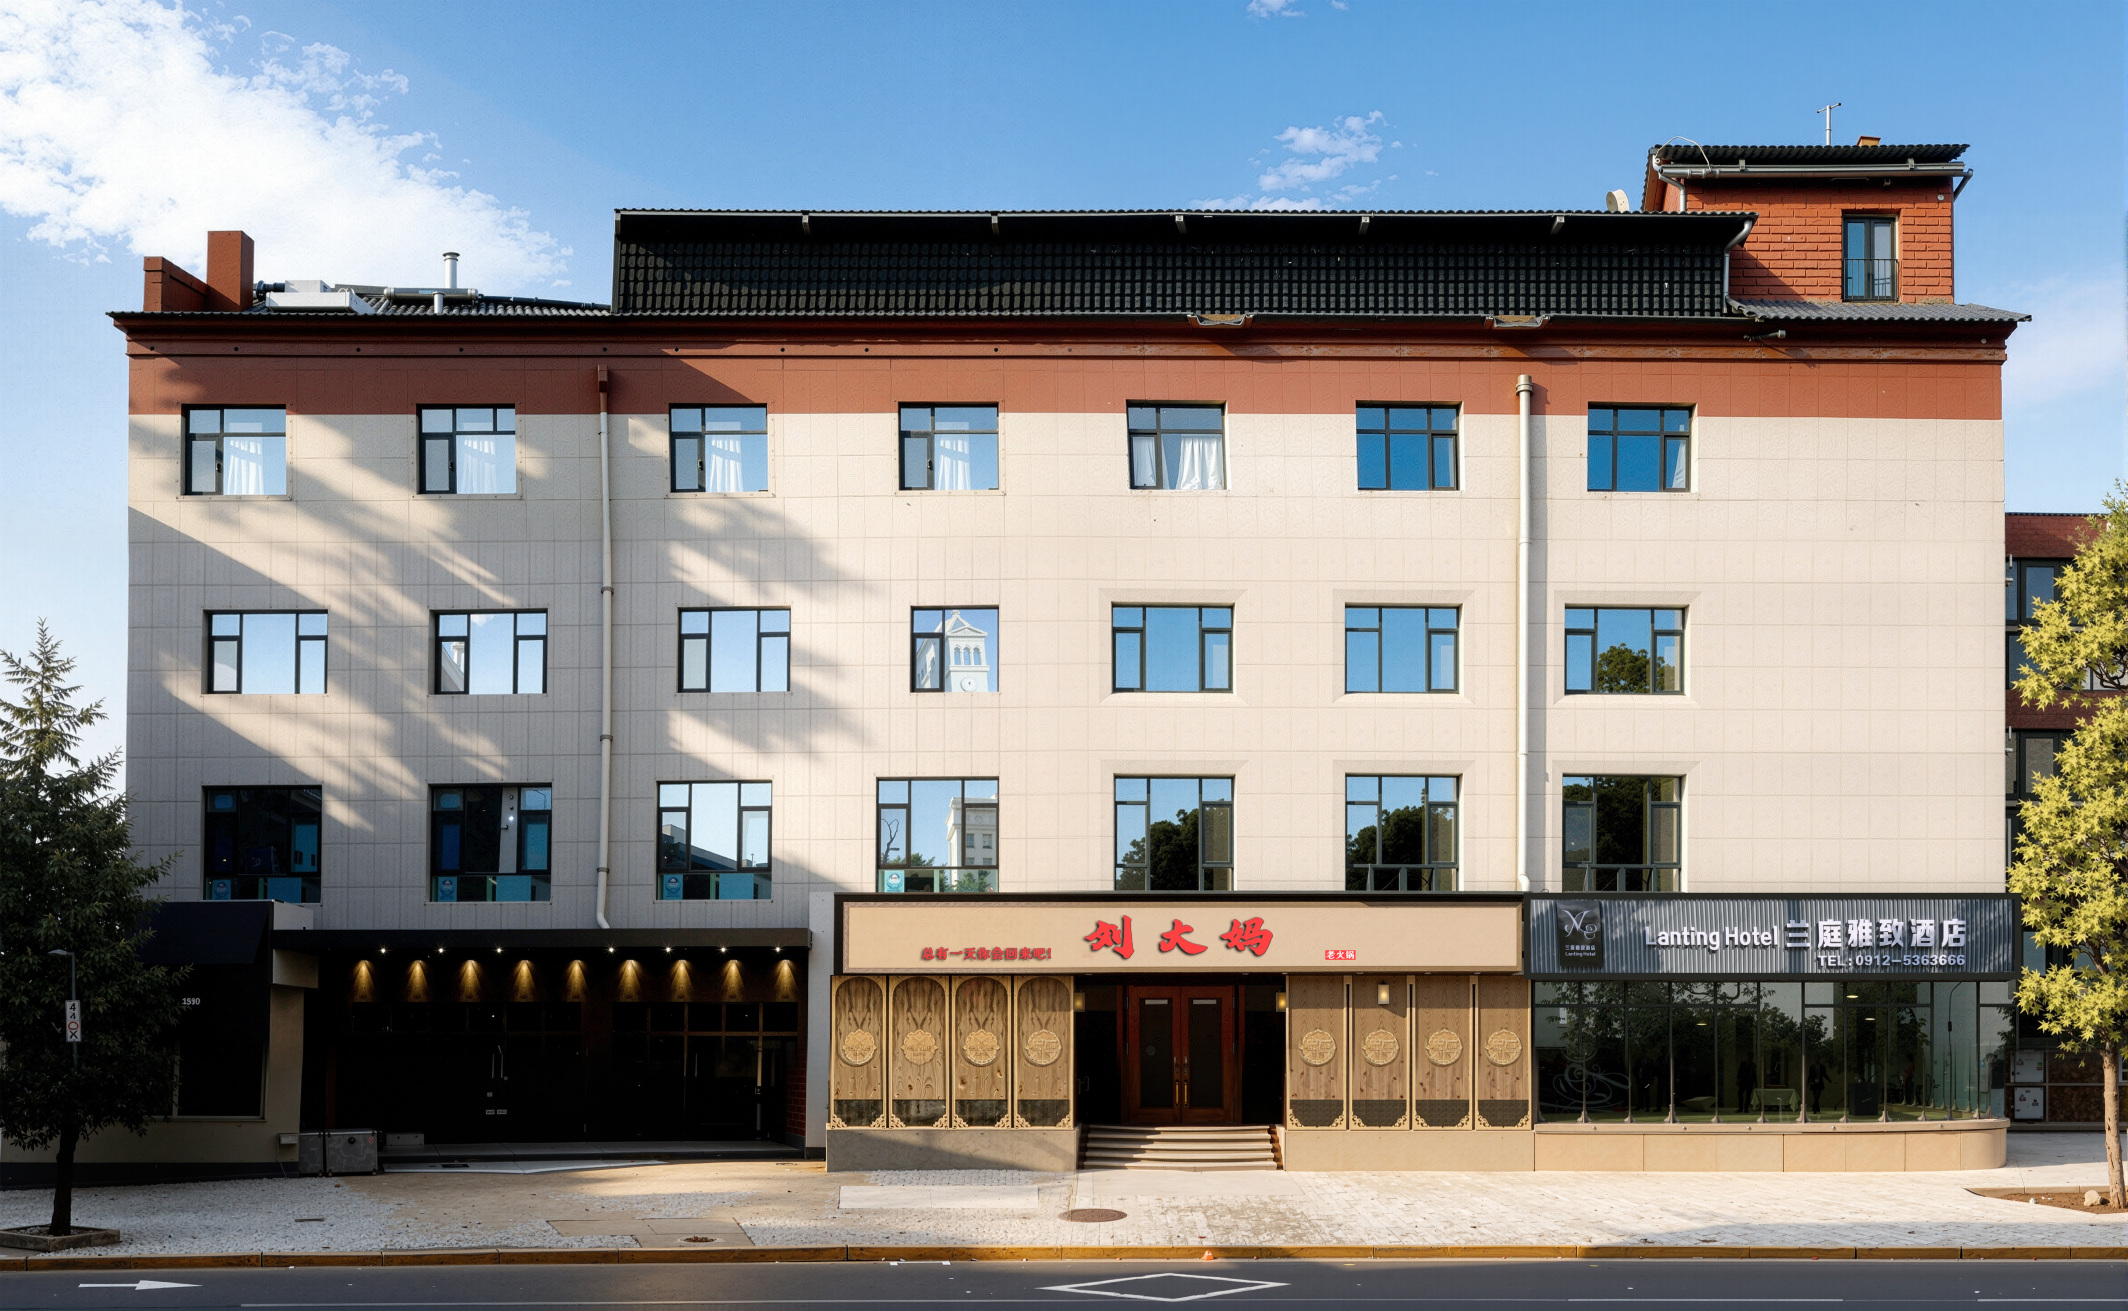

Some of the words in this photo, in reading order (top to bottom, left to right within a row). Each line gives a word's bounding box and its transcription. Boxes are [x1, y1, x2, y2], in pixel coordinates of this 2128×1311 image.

[1084, 915, 1273, 959] 刘大妈
[1646, 926, 1720, 950] Lanting
[1725, 926, 1778, 946] Hotel
[1786, 919, 1967, 949] 兰庭雅致酒店
[1326, 950, 1355, 960] 老火锅
